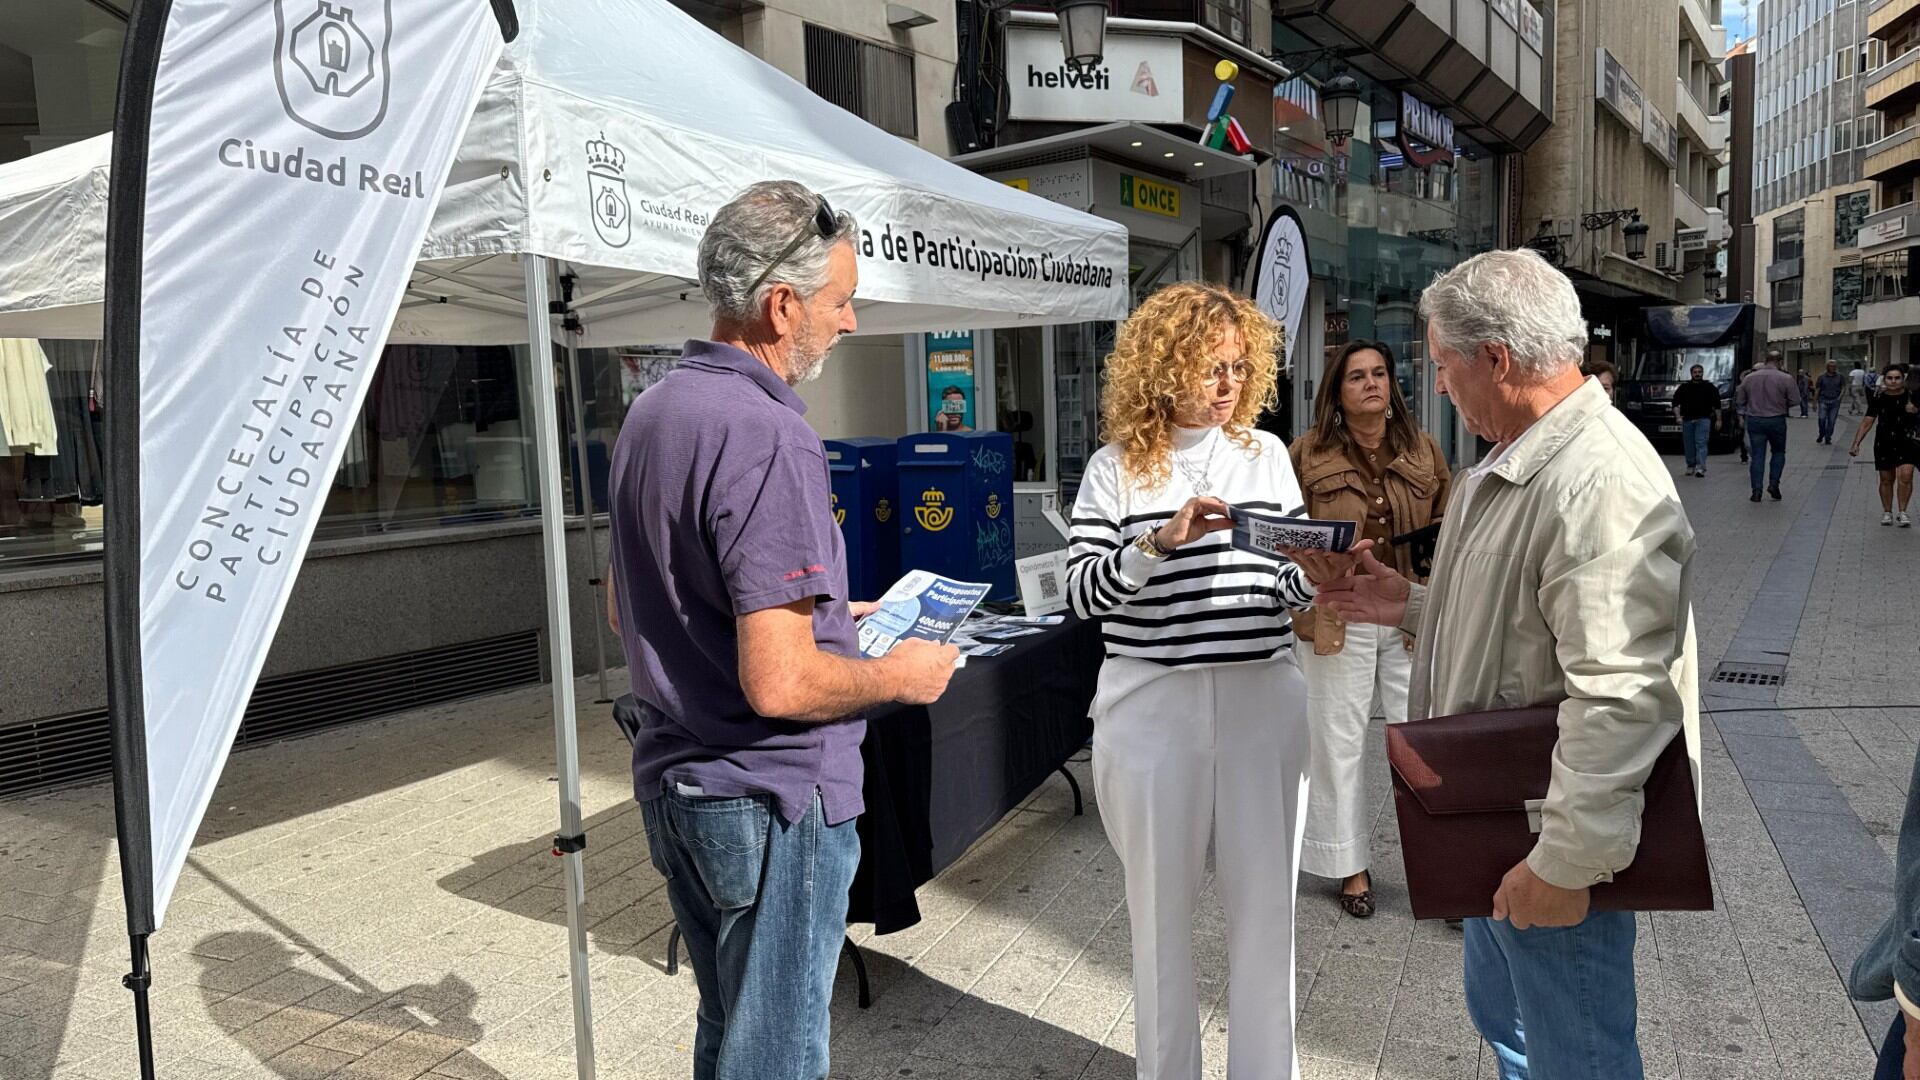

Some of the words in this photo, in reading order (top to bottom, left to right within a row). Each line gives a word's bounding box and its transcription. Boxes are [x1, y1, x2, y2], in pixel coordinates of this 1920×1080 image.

[1402, 90, 1455, 149] PRIMOR
[218, 138, 347, 187] Ciudad
[359, 163, 425, 199] Real
[1138, 183, 1175, 213] ONCE
[640, 199, 682, 221] Ciudad
[684, 209, 710, 226] Real
[642, 218, 703, 237] AYUNTAMIEN
[881, 223, 908, 263] de
[913, 230, 1037, 281] Participación
[1041, 253, 1113, 289] Ciudadana
[176, 325, 307, 592] CONCEJALÍA
[300, 249, 337, 299] DE
[205, 264, 365, 603] PARTICIPACIÓN
[257, 325, 371, 566] CIUDADANA
